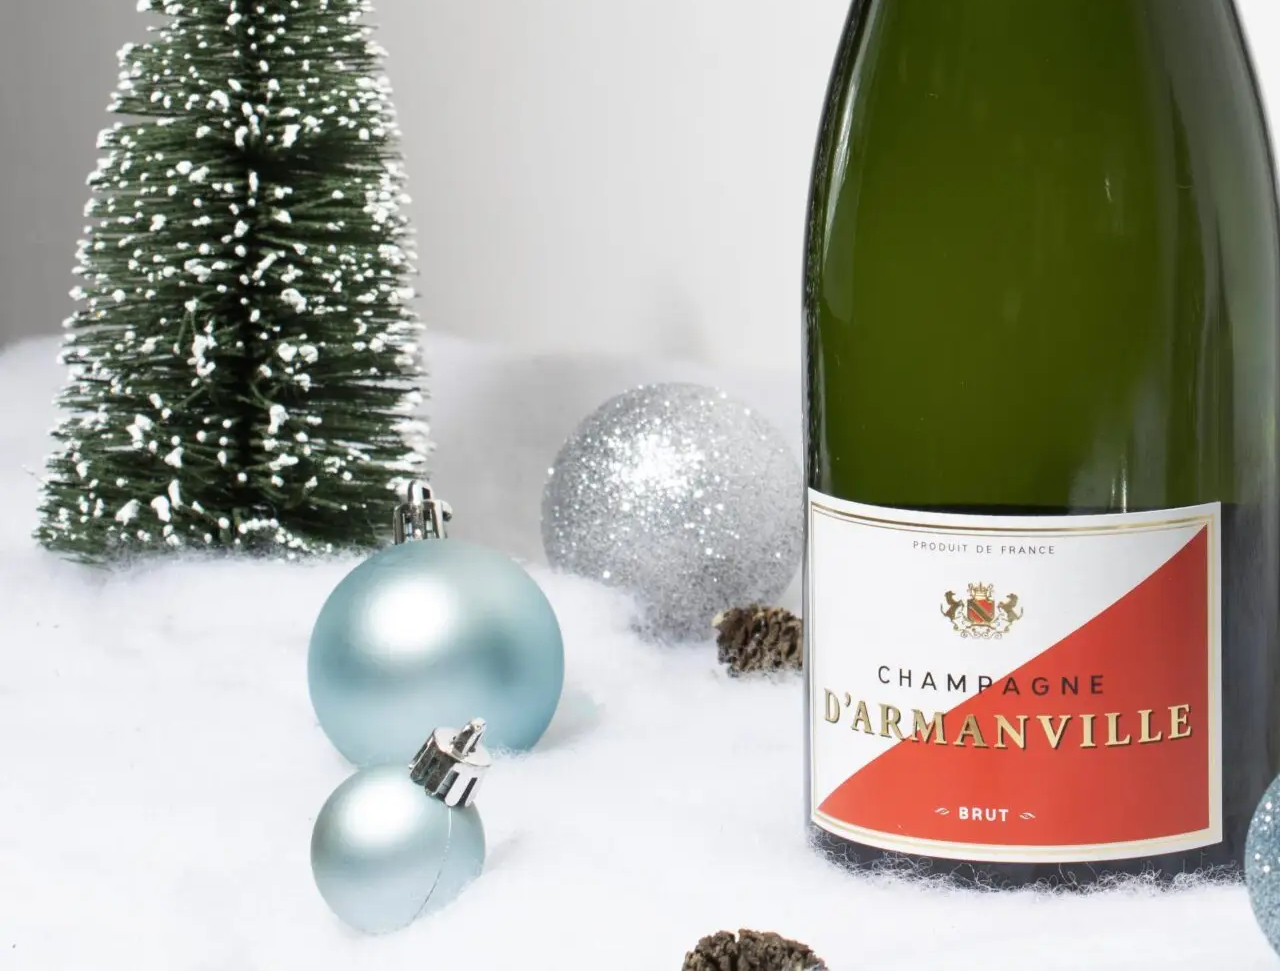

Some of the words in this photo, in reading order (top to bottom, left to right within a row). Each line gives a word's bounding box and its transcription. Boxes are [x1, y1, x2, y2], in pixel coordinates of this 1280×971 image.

[912, 540, 968, 554] PRODUIT
[976, 544, 993, 554] DE
[1001, 545, 1056, 555] FRANCE
[878, 664, 1106, 696] CHAMPAGNE
[823, 687, 1194, 751] D'ARMANVILLE
[958, 806, 1009, 822] BRUT
